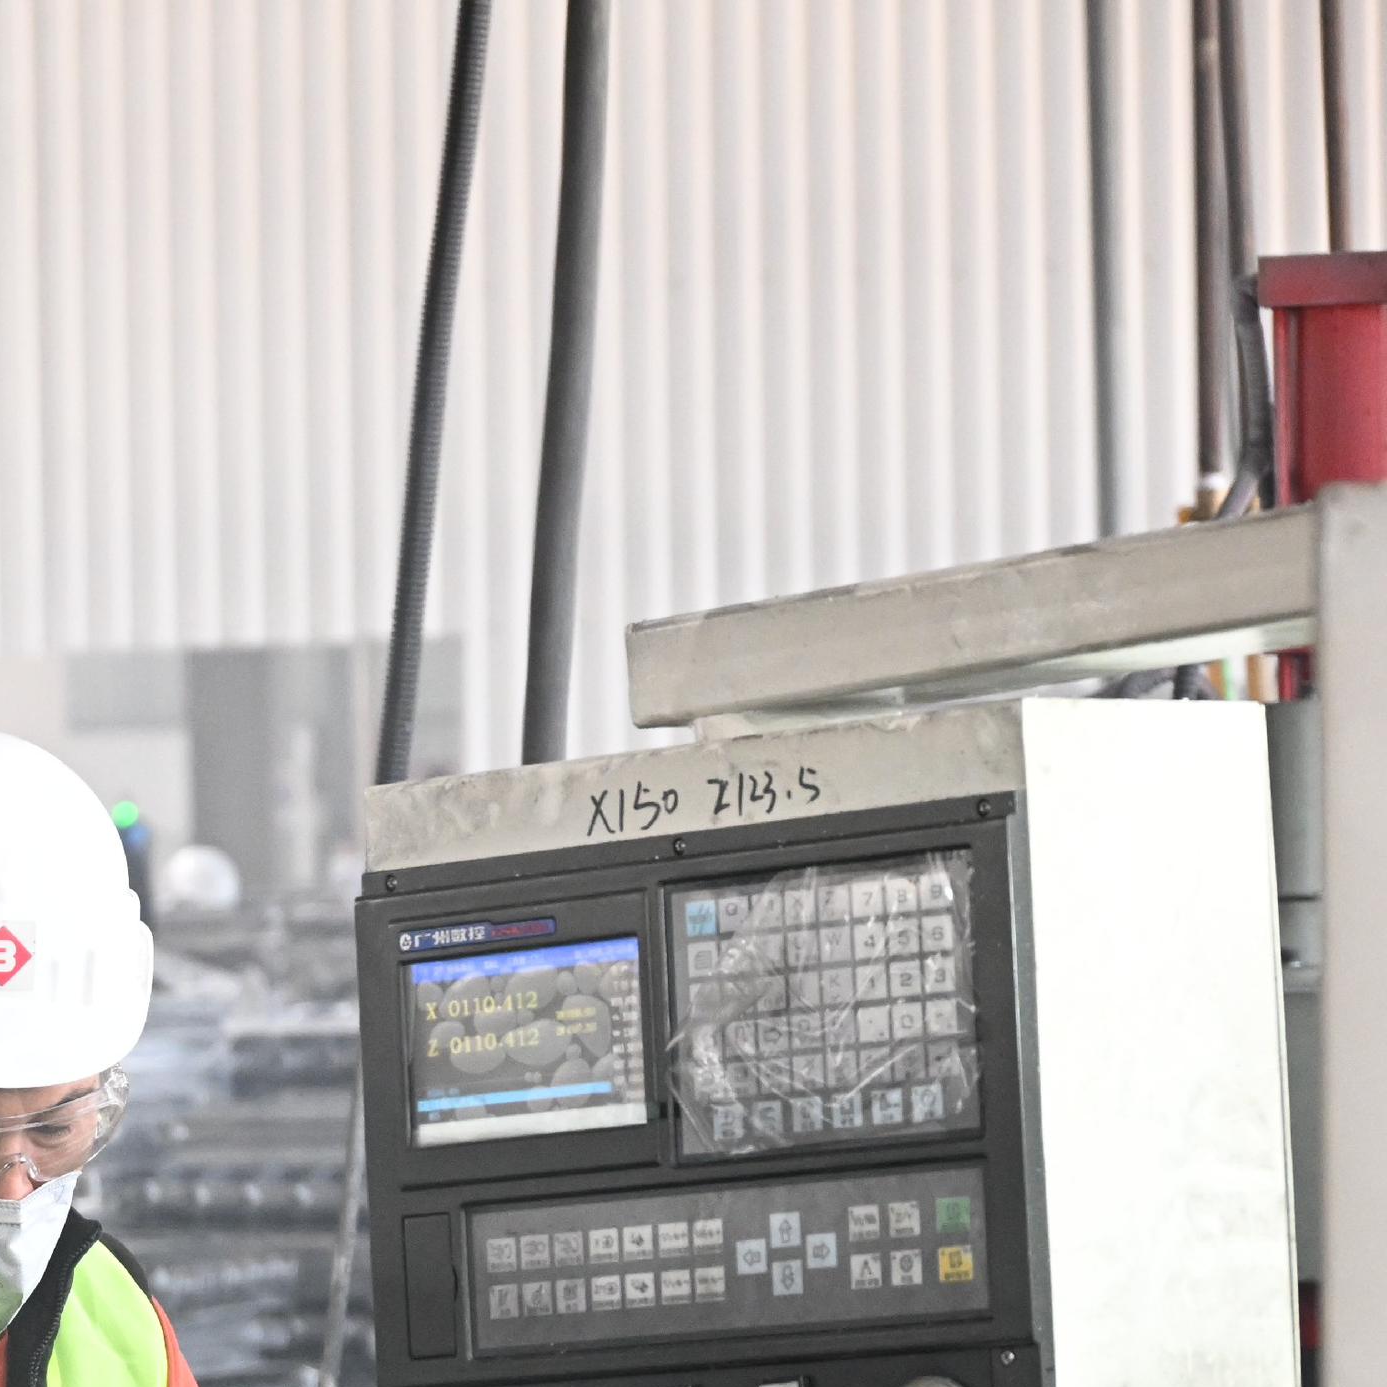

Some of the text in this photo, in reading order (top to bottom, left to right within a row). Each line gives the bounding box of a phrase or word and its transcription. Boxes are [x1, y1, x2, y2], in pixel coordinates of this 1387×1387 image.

[586, 780, 679, 837] X150
[896, 888, 908, 904] 8
[930, 884, 943, 900] 9
[897, 929, 909, 946] 5
[931, 926, 944, 941] 6
[899, 972, 913, 987] 2
[934, 967, 946, 984] 3
[425, 1001, 438, 1021] X
[427, 1037, 440, 1058] Z
